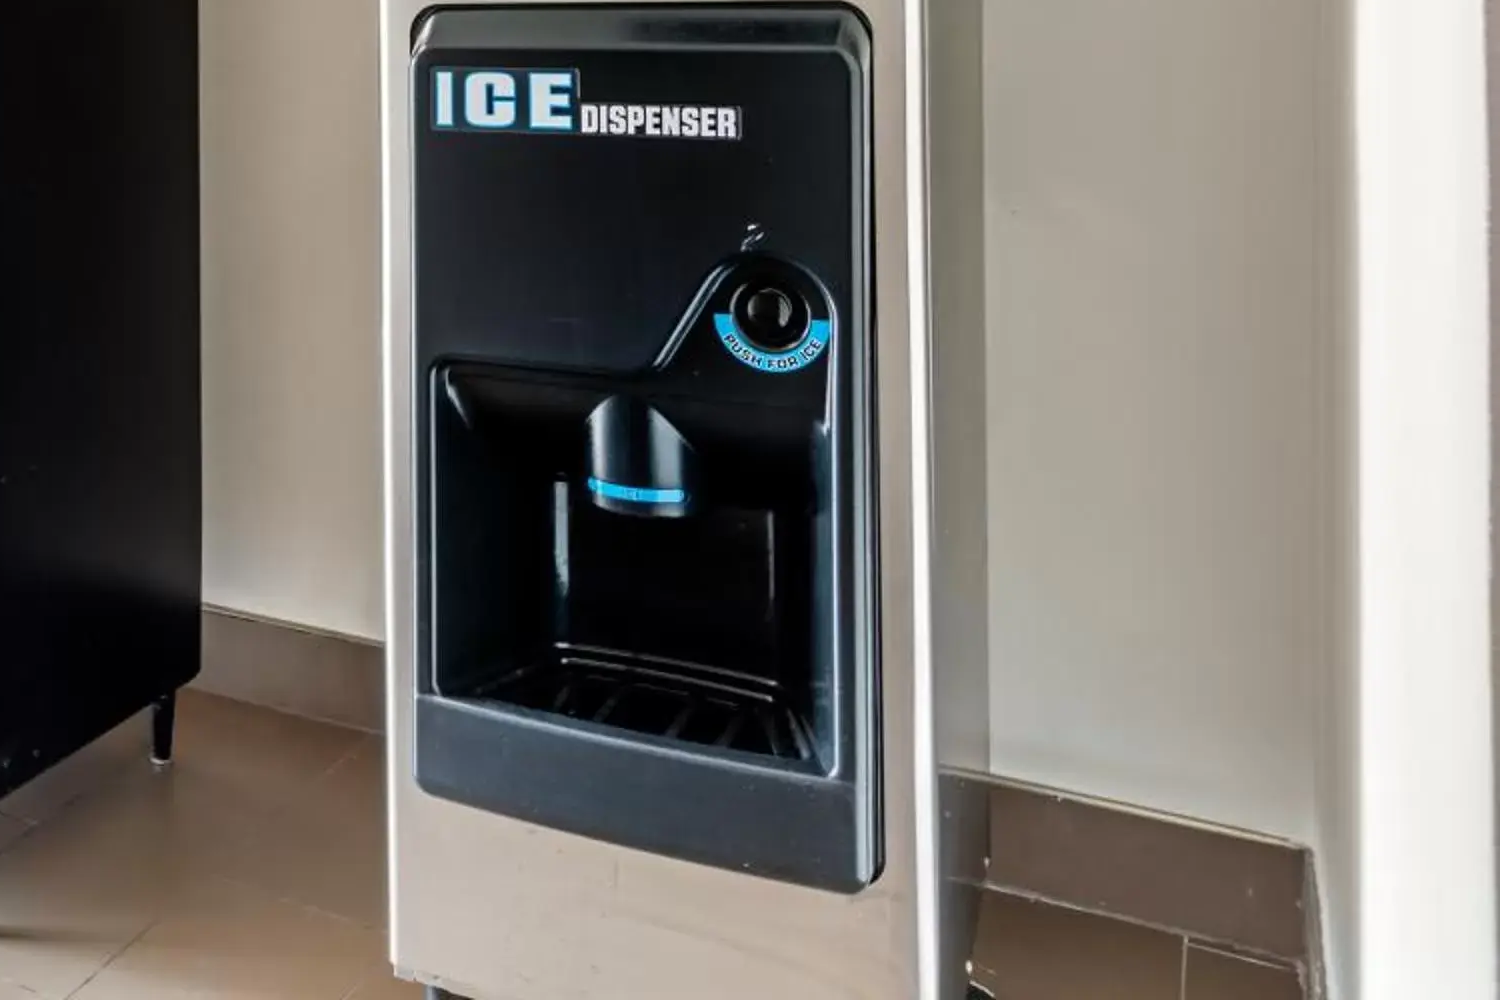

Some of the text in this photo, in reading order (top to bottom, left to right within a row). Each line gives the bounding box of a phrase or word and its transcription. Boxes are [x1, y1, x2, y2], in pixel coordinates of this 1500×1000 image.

[435, 71, 738, 139] ICE DISPENSER
[724, 333, 822, 369] PUSH FOR ICE
